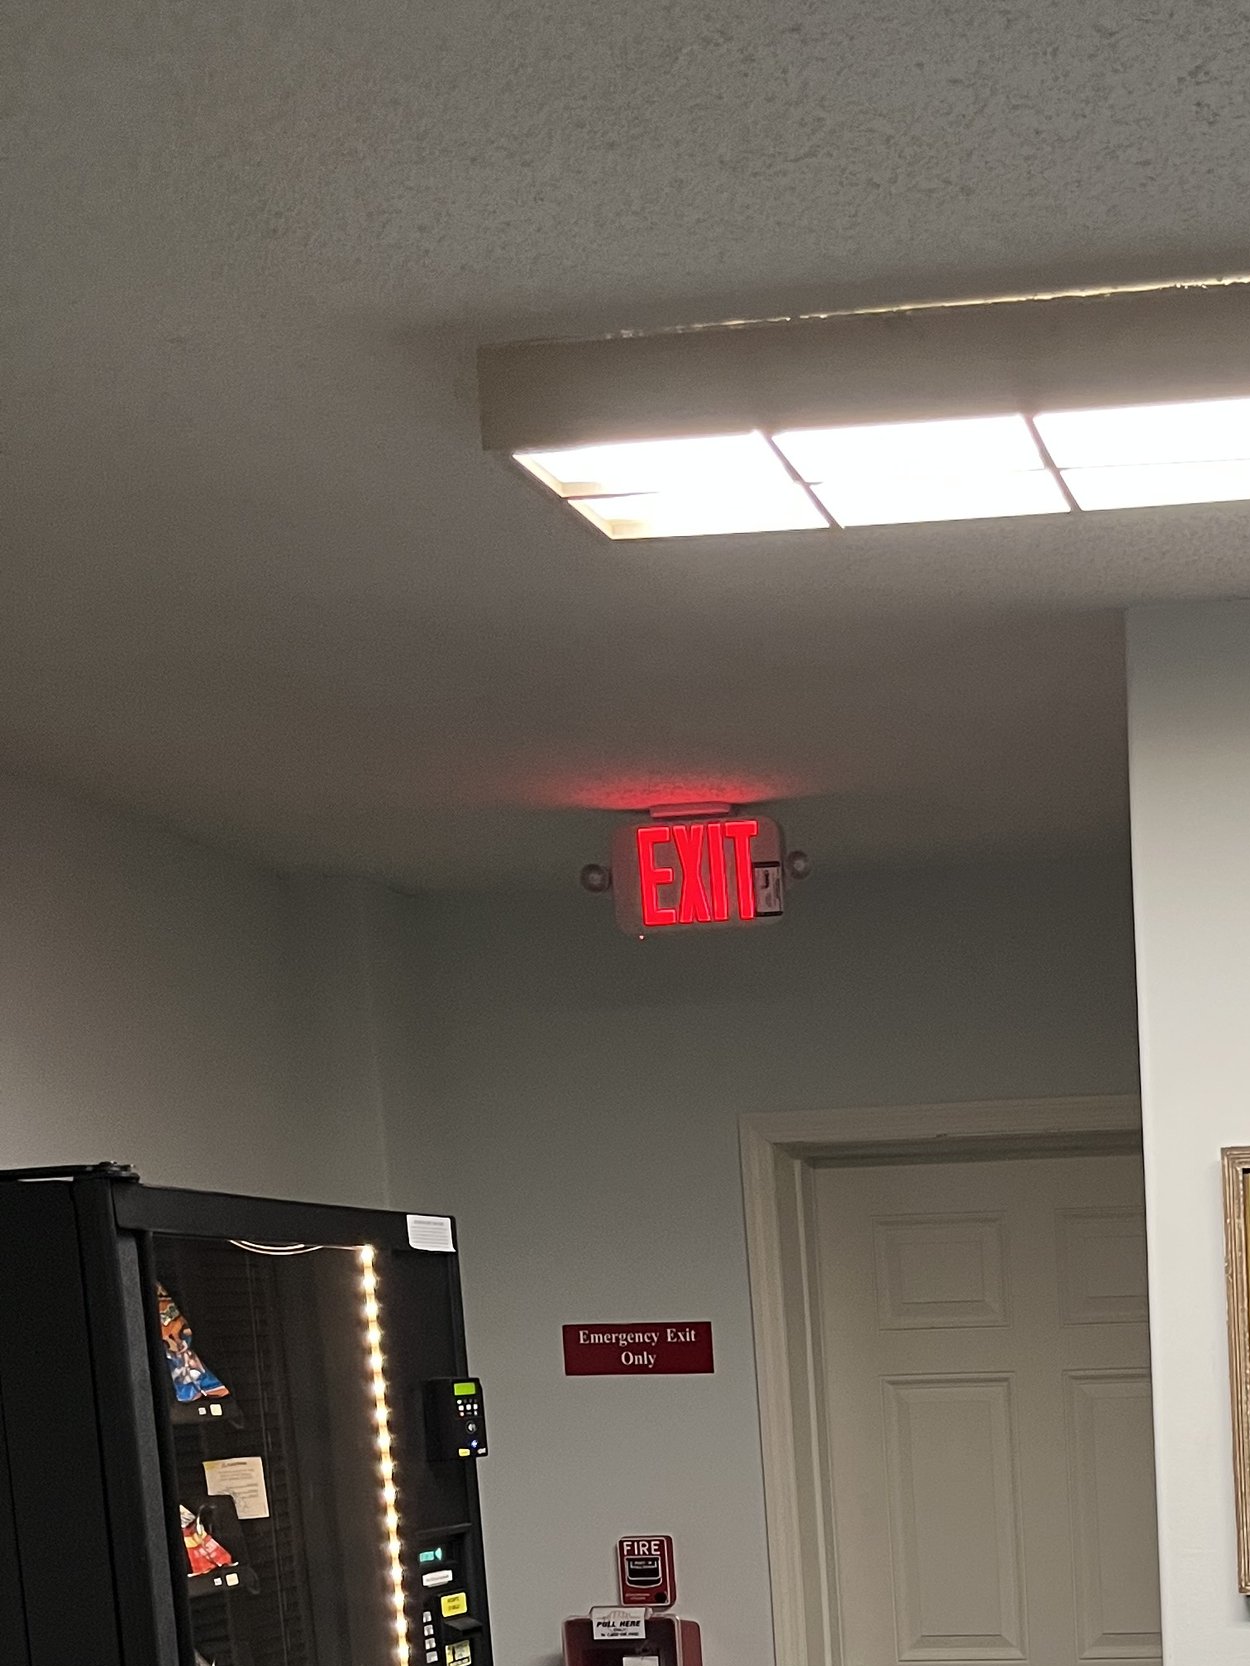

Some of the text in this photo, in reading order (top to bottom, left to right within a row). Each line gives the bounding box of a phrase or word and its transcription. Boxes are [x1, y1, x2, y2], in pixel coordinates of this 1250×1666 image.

[637, 820, 758, 926] EXIT
[578, 1328, 697, 1347] Emergency Exit
[620, 1351, 657, 1368] Only
[623, 1541, 661, 1556] FIRE
[596, 1620, 641, 1628] PULL HERE
